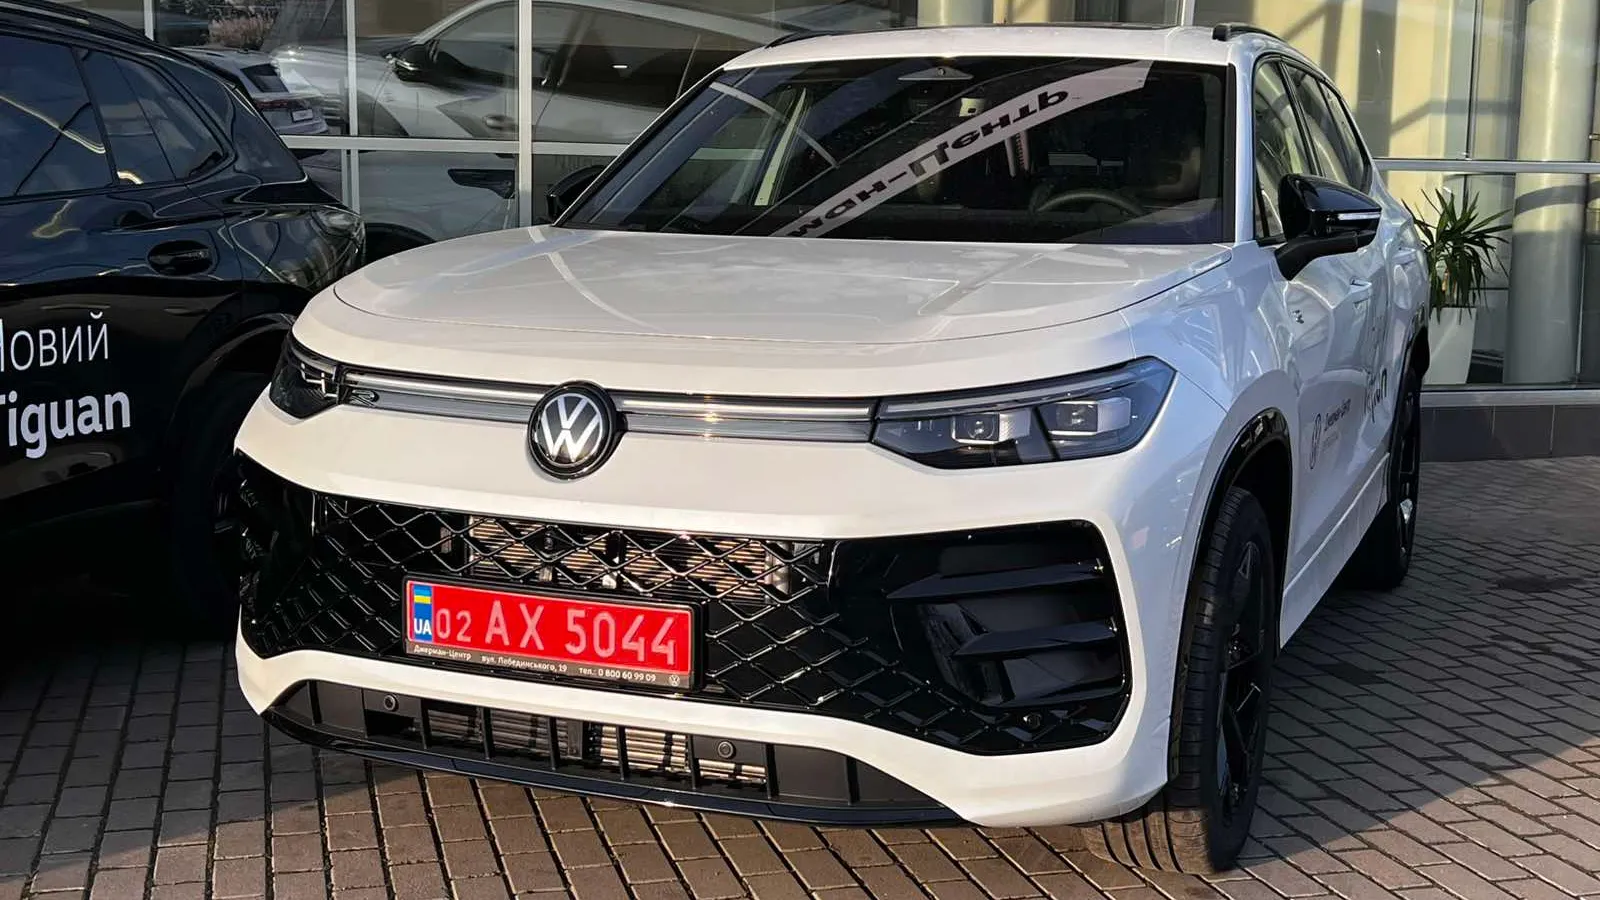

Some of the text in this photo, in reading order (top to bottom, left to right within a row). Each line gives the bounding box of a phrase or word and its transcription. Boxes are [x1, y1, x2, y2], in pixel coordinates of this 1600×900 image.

[413, 618, 432, 635] UA
[435, 600, 675, 665] 02 AX 5044
[413, 644, 472, 661] Джерман-Центр
[558, 664, 568, 673] 19
[598, 668, 604, 677] 0
[605, 669, 621, 679] 800
[622, 671, 633, 680] 60
[633, 672, 644, 681] 99
[645, 673, 657, 682] 09
